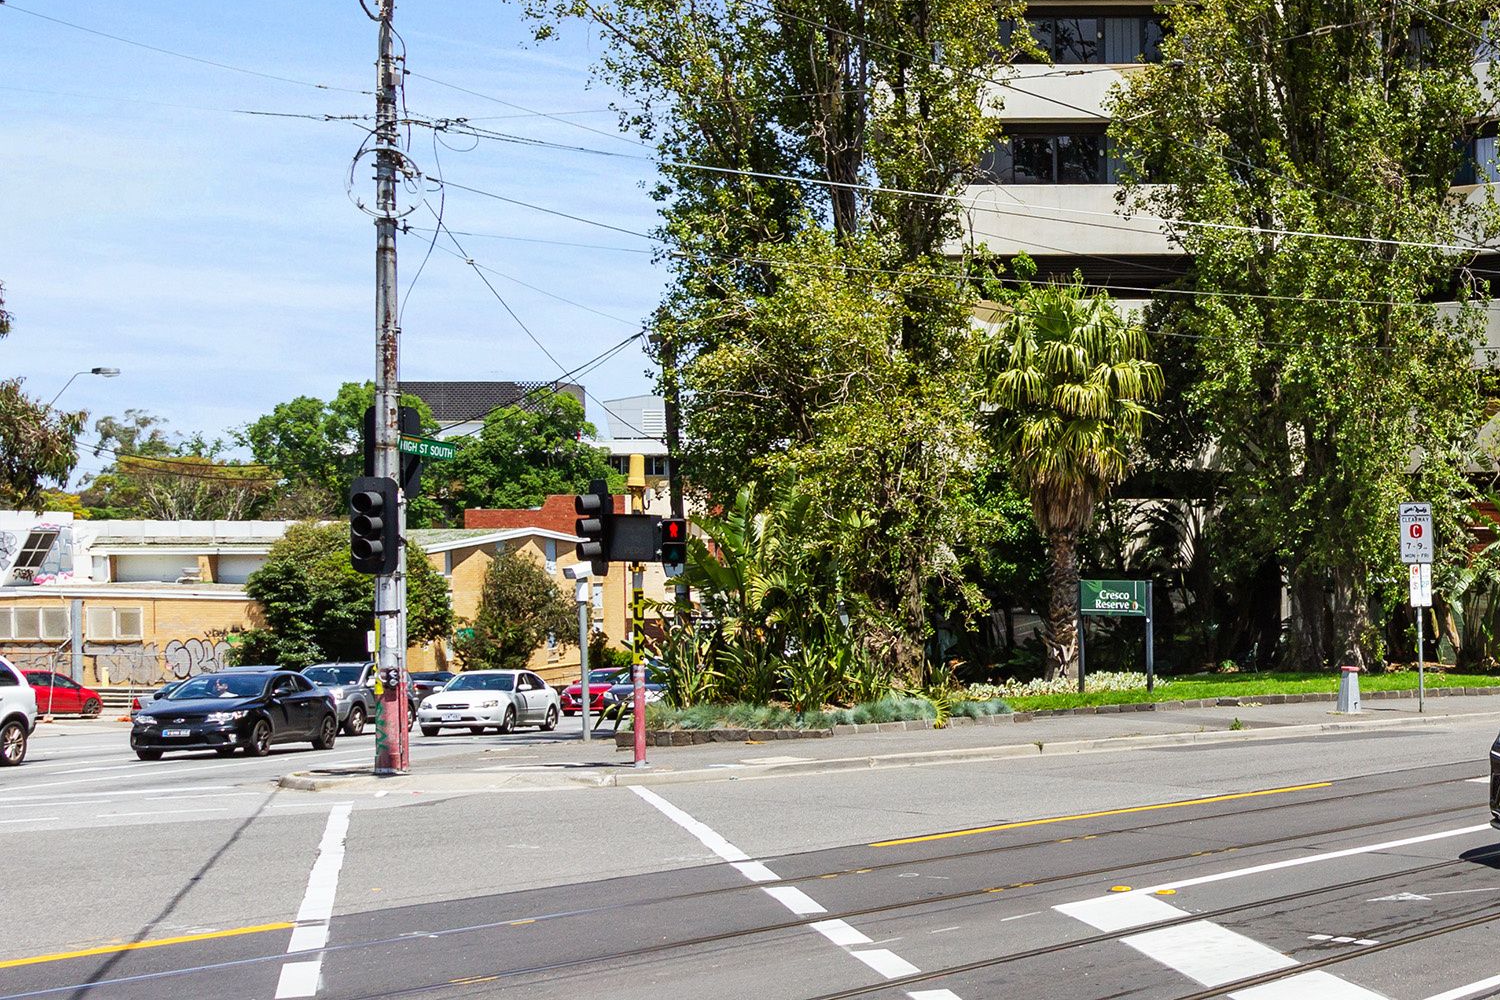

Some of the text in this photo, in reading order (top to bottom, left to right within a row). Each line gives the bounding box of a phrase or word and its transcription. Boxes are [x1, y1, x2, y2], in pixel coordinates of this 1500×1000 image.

[400, 440, 453, 458] HIGH ST SOUTH
[1099, 590, 1130, 600] Cresco
[1095, 599, 1130, 609] Reserve
